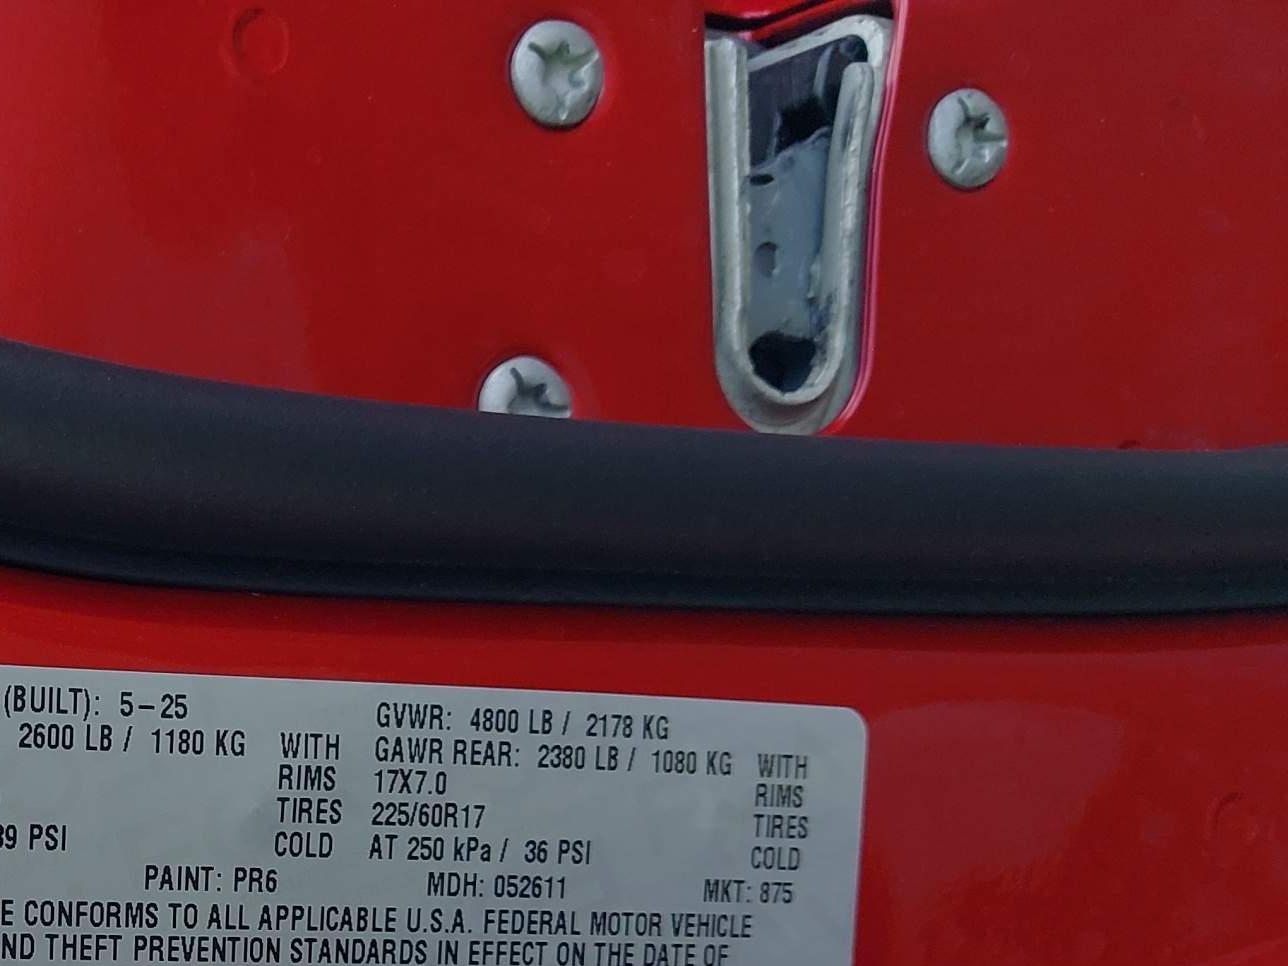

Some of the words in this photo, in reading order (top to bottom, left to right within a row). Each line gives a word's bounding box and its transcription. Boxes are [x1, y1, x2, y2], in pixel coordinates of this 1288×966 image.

[4, 684, 100, 722] (BUILT):
[120, 691, 188, 720] 5-25
[376, 701, 452, 731] GVWR:
[469, 707, 519, 734] 4800
[528, 708, 553, 735] LB
[561, 710, 571, 736] /
[585, 713, 633, 739] 2178
[642, 714, 669, 740] KG
[18, 722, 74, 750] 2600
[85, 723, 113, 752] LB
[122, 725, 133, 753] /
[151, 728, 205, 755] 1180
[215, 729, 245, 757] KG
[280, 731, 340, 761] WITH
[375, 735, 443, 765] GAWR
[452, 739, 520, 768] REAR:
[537, 743, 586, 770] 2380
[595, 745, 619, 771] LB
[626, 746, 637, 772] /
[651, 749, 697, 775] 1080
[706, 750, 732, 777] KG
[757, 753, 808, 780] WITH
[278, 763, 337, 792] RIMS
[374, 767, 448, 796] 17X7.0
[754, 782, 804, 809] RIMS
[276, 796, 343, 825] TIRES
[371, 801, 486, 829] 225/60R17
[29, 823, 67, 852] PSI
[752, 813, 809, 840] TIRES
[274, 831, 333, 858] COLD
[368, 833, 399, 860] AT
[406, 836, 445, 861] 250
[453, 836, 492, 863] kPa
[499, 837, 510, 863] /
[524, 839, 549, 864] 36
[557, 839, 591, 865] PSI
[750, 845, 801, 871] COLD
[144, 864, 222, 892] PAINT:
[233, 866, 278, 893] PR6
[427, 871, 484, 898] MDH:
[494, 874, 566, 899] 052611
[703, 878, 752, 903] MKT:
[759, 881, 793, 904] 875
[24, 899, 159, 929] CONFORMS
[167, 902, 198, 930] TO
[206, 903, 250, 930] ALL
[257, 904, 397, 933] APPLICABLE
[406, 907, 472, 934] U.S.A.
[483, 909, 581, 936] FEDERAL
[589, 911, 662, 937] MOTOR
[671, 912, 753, 939] VEHICLE
[44, 933, 123, 961] THEFT
[133, 935, 281, 964] PREVENTION
[290, 937, 428, 965] STANDARDS
[437, 939, 459, 966] IN
[468, 940, 549, 966] EFFECT
[556, 941, 586, 966] ON
